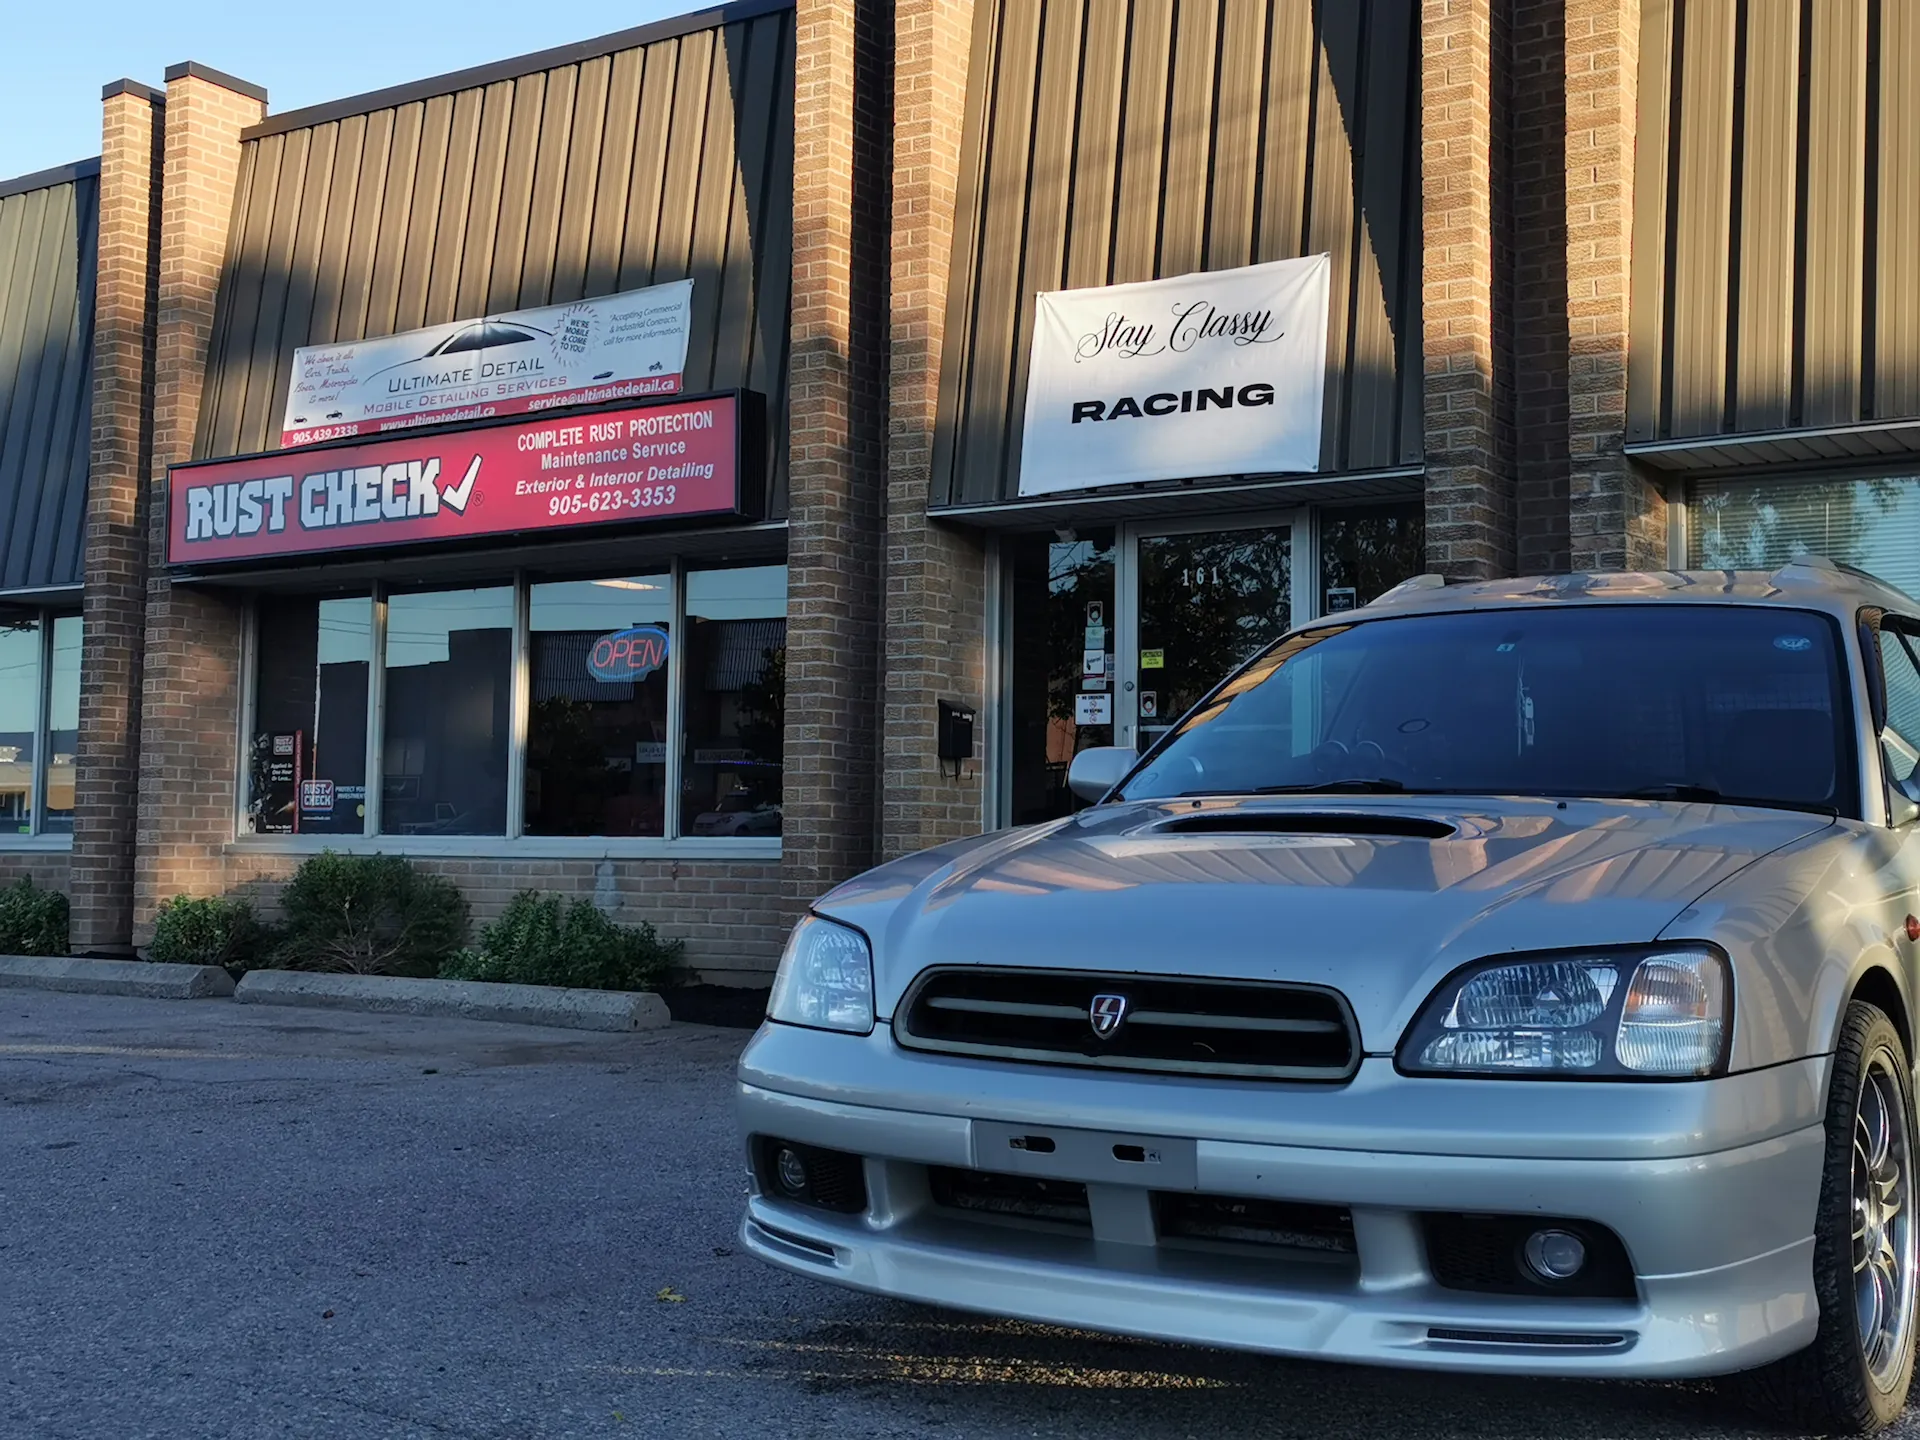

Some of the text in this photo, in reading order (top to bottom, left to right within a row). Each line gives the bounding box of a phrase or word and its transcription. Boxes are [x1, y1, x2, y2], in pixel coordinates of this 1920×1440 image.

[643, 301, 683, 316] Commercial
[565, 326, 590, 338] MOBILE
[568, 335, 588, 346] COME
[603, 336, 615, 347] call
[614, 335, 626, 345] for
[626, 334, 642, 343] more
[615, 320, 646, 333] Industrial
[1074, 300, 1284, 363] Stay Classy
[560, 342, 570, 351] TO
[388, 357, 545, 393] ULTIMATE DETAIL
[363, 375, 568, 415] MOBILE DETAILING SERVICES
[1071, 383, 1275, 424] RACING
[292, 379, 675, 444] 905.439.2338 www.ultimatedetail.ca service@ultimatedetail.ca
[517, 410, 713, 452] COMPLETE RUST PROTECTION
[541, 441, 686, 470] Maintenance Service
[515, 461, 714, 495] Exterior & Interior Detailing
[185, 457, 442, 542] RUST CHECK
[548, 485, 676, 516] 905-623-3353
[1181, 566, 1221, 587] 161
[593, 638, 664, 668] OPEN
[304, 783, 327, 795] RUST
[304, 795, 332, 806] CHECK
